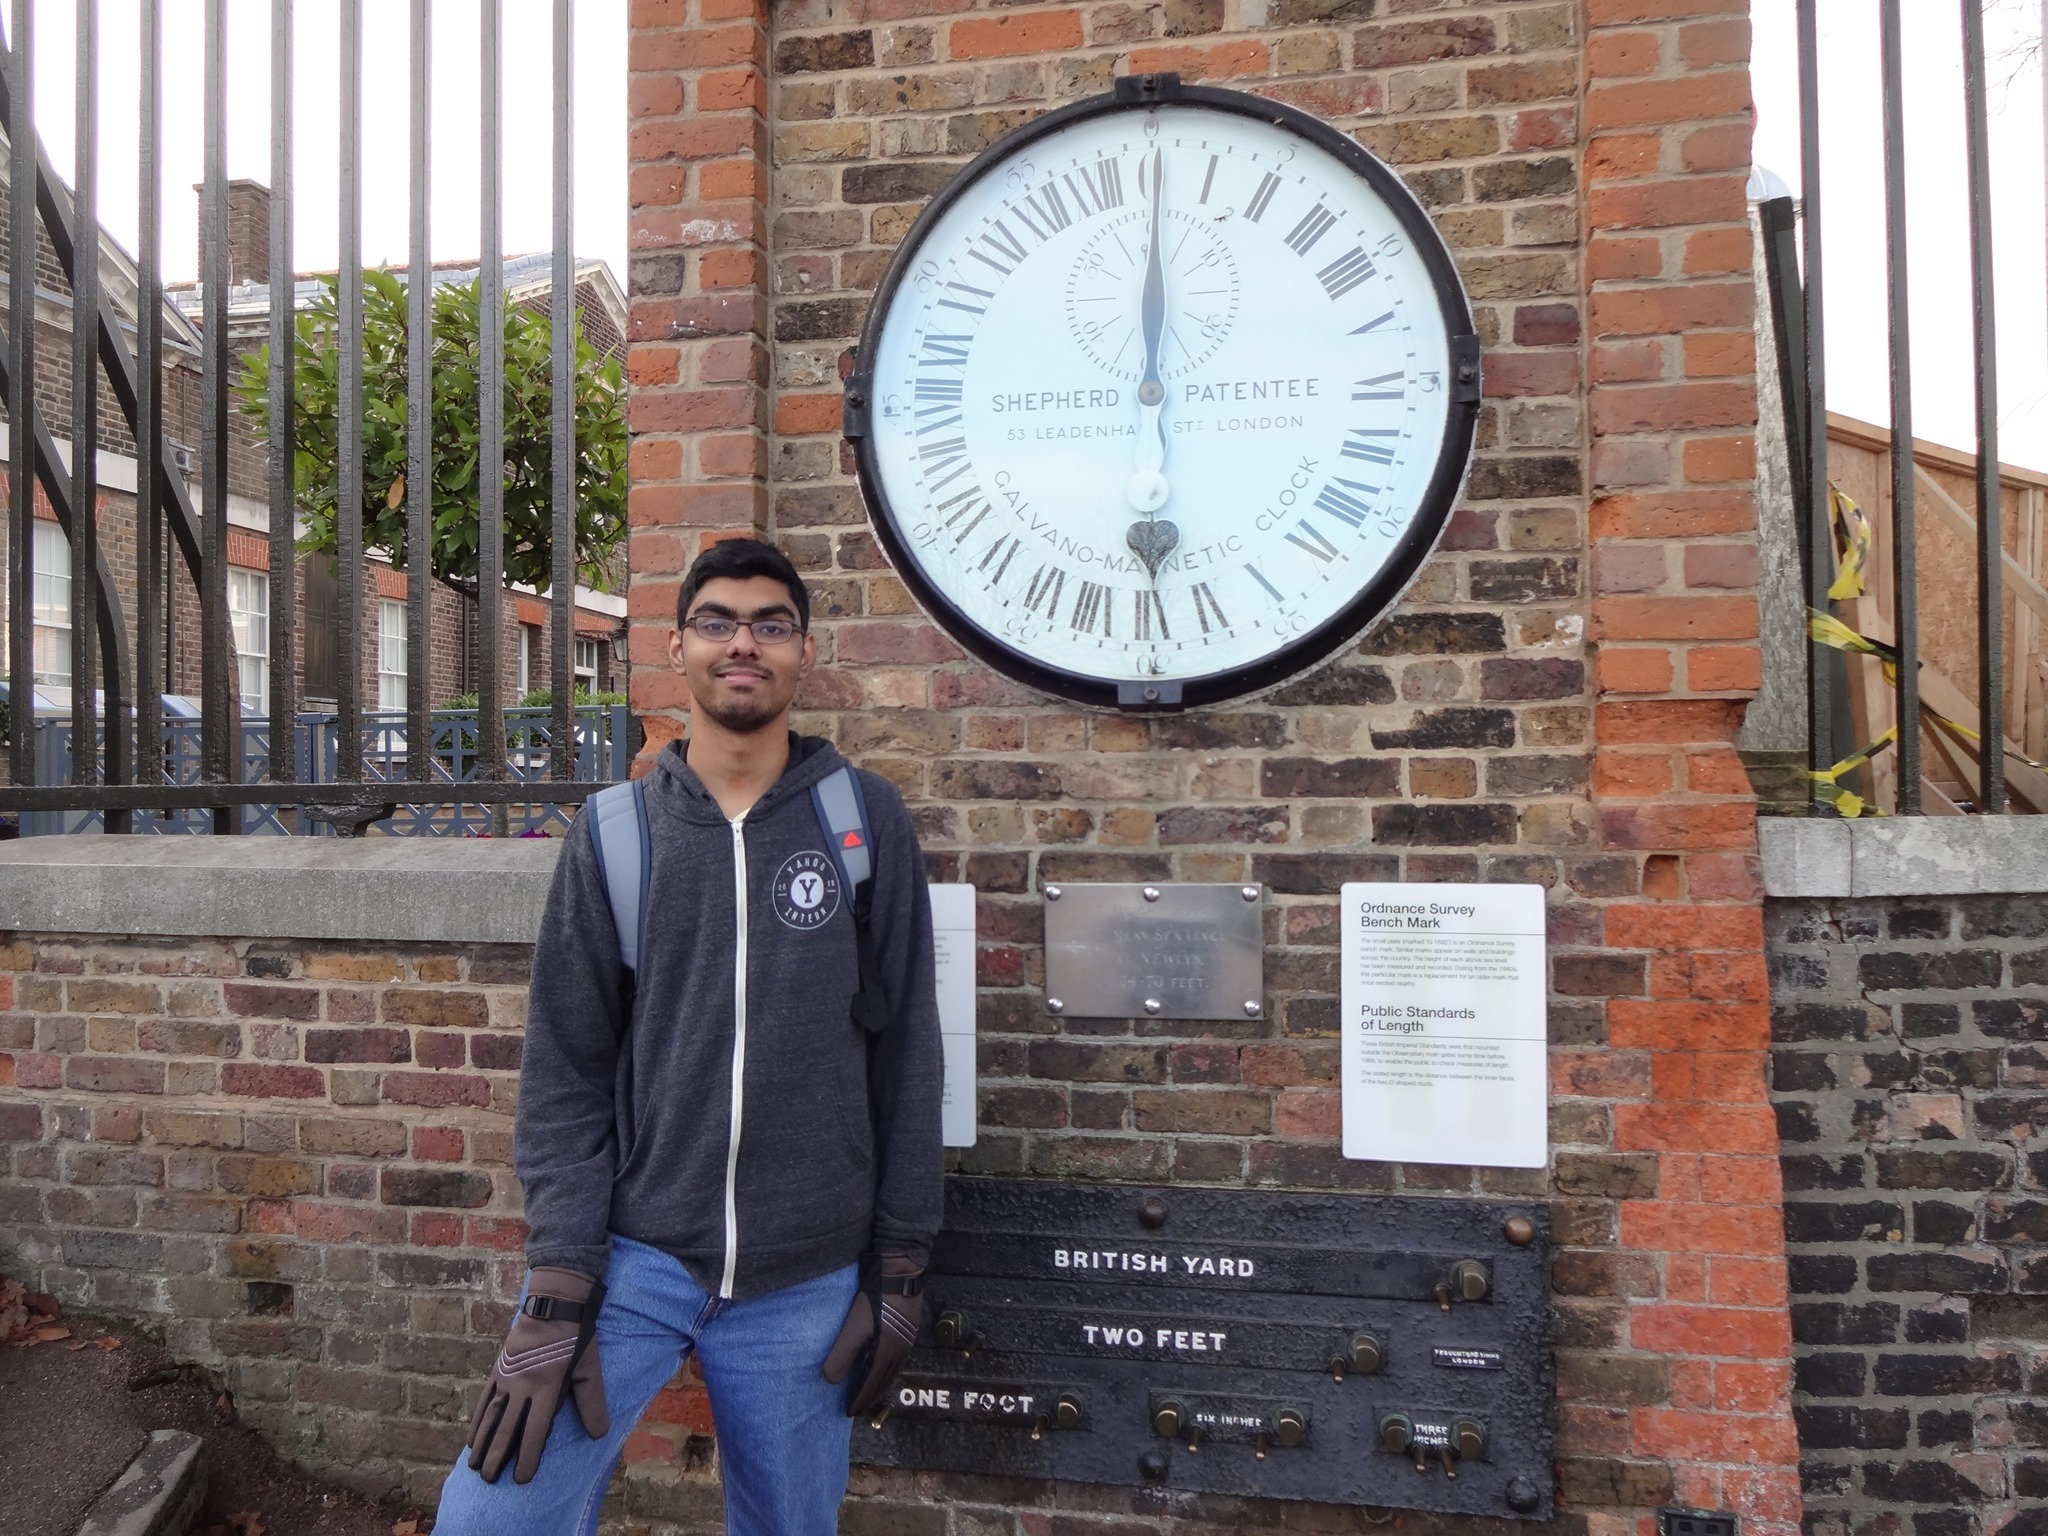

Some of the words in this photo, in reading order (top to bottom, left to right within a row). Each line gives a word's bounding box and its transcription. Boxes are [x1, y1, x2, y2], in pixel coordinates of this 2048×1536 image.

[1143, 119, 1160, 137] 0
[1277, 143, 1299, 163] 5
[1006, 158, 1036, 190] 55
[1283, 202, 1338, 258] III
[1201, 248, 1220, 267] 10
[1377, 232, 1404, 258] 10
[913, 260, 940, 294] 50
[1419, 370, 1441, 393] 15
[992, 389, 1119, 412] SHEPHERD
[1185, 378, 1320, 402] PATENTEE
[1007, 428, 1025, 441] 53
[1217, 416, 1303, 432] LONDON
[994, 470, 1243, 575] GALVANO-MANETIC
[1255, 455, 1319, 531] CLOCK
[1377, 505, 1406, 538] 20
[913, 522, 938, 551] 40
[1273, 610, 1307, 641] 25
[787, 857, 826, 874] YAHOO
[778, 883, 787, 891] 20
[798, 878, 818, 904] Y
[785, 906, 827, 923] INTERN
[1361, 902, 1425, 914] Ordnance
[1430, 903, 1475, 918] Survey
[1361, 916, 1403, 928] Bench
[1407, 917, 1441, 929] Mark
[1361, 1004, 1402, 1017] Public
[1406, 1006, 1476, 1019] Standards
[1361, 1019, 1374, 1030] of
[1378, 1019, 1424, 1034] Length
[1054, 1250, 1167, 1273] BRITISH
[1182, 1256, 1255, 1277] YARD
[1083, 1326, 1144, 1347] TWO
[1157, 1329, 1228, 1351] FEET
[900, 1388, 950, 1409] ONE
[964, 1391, 1034, 1413] FOOT
[1196, 1413, 1216, 1424] SIX
[1221, 1416, 1262, 1427] INCHES
[1415, 1424, 1449, 1436] THREE
